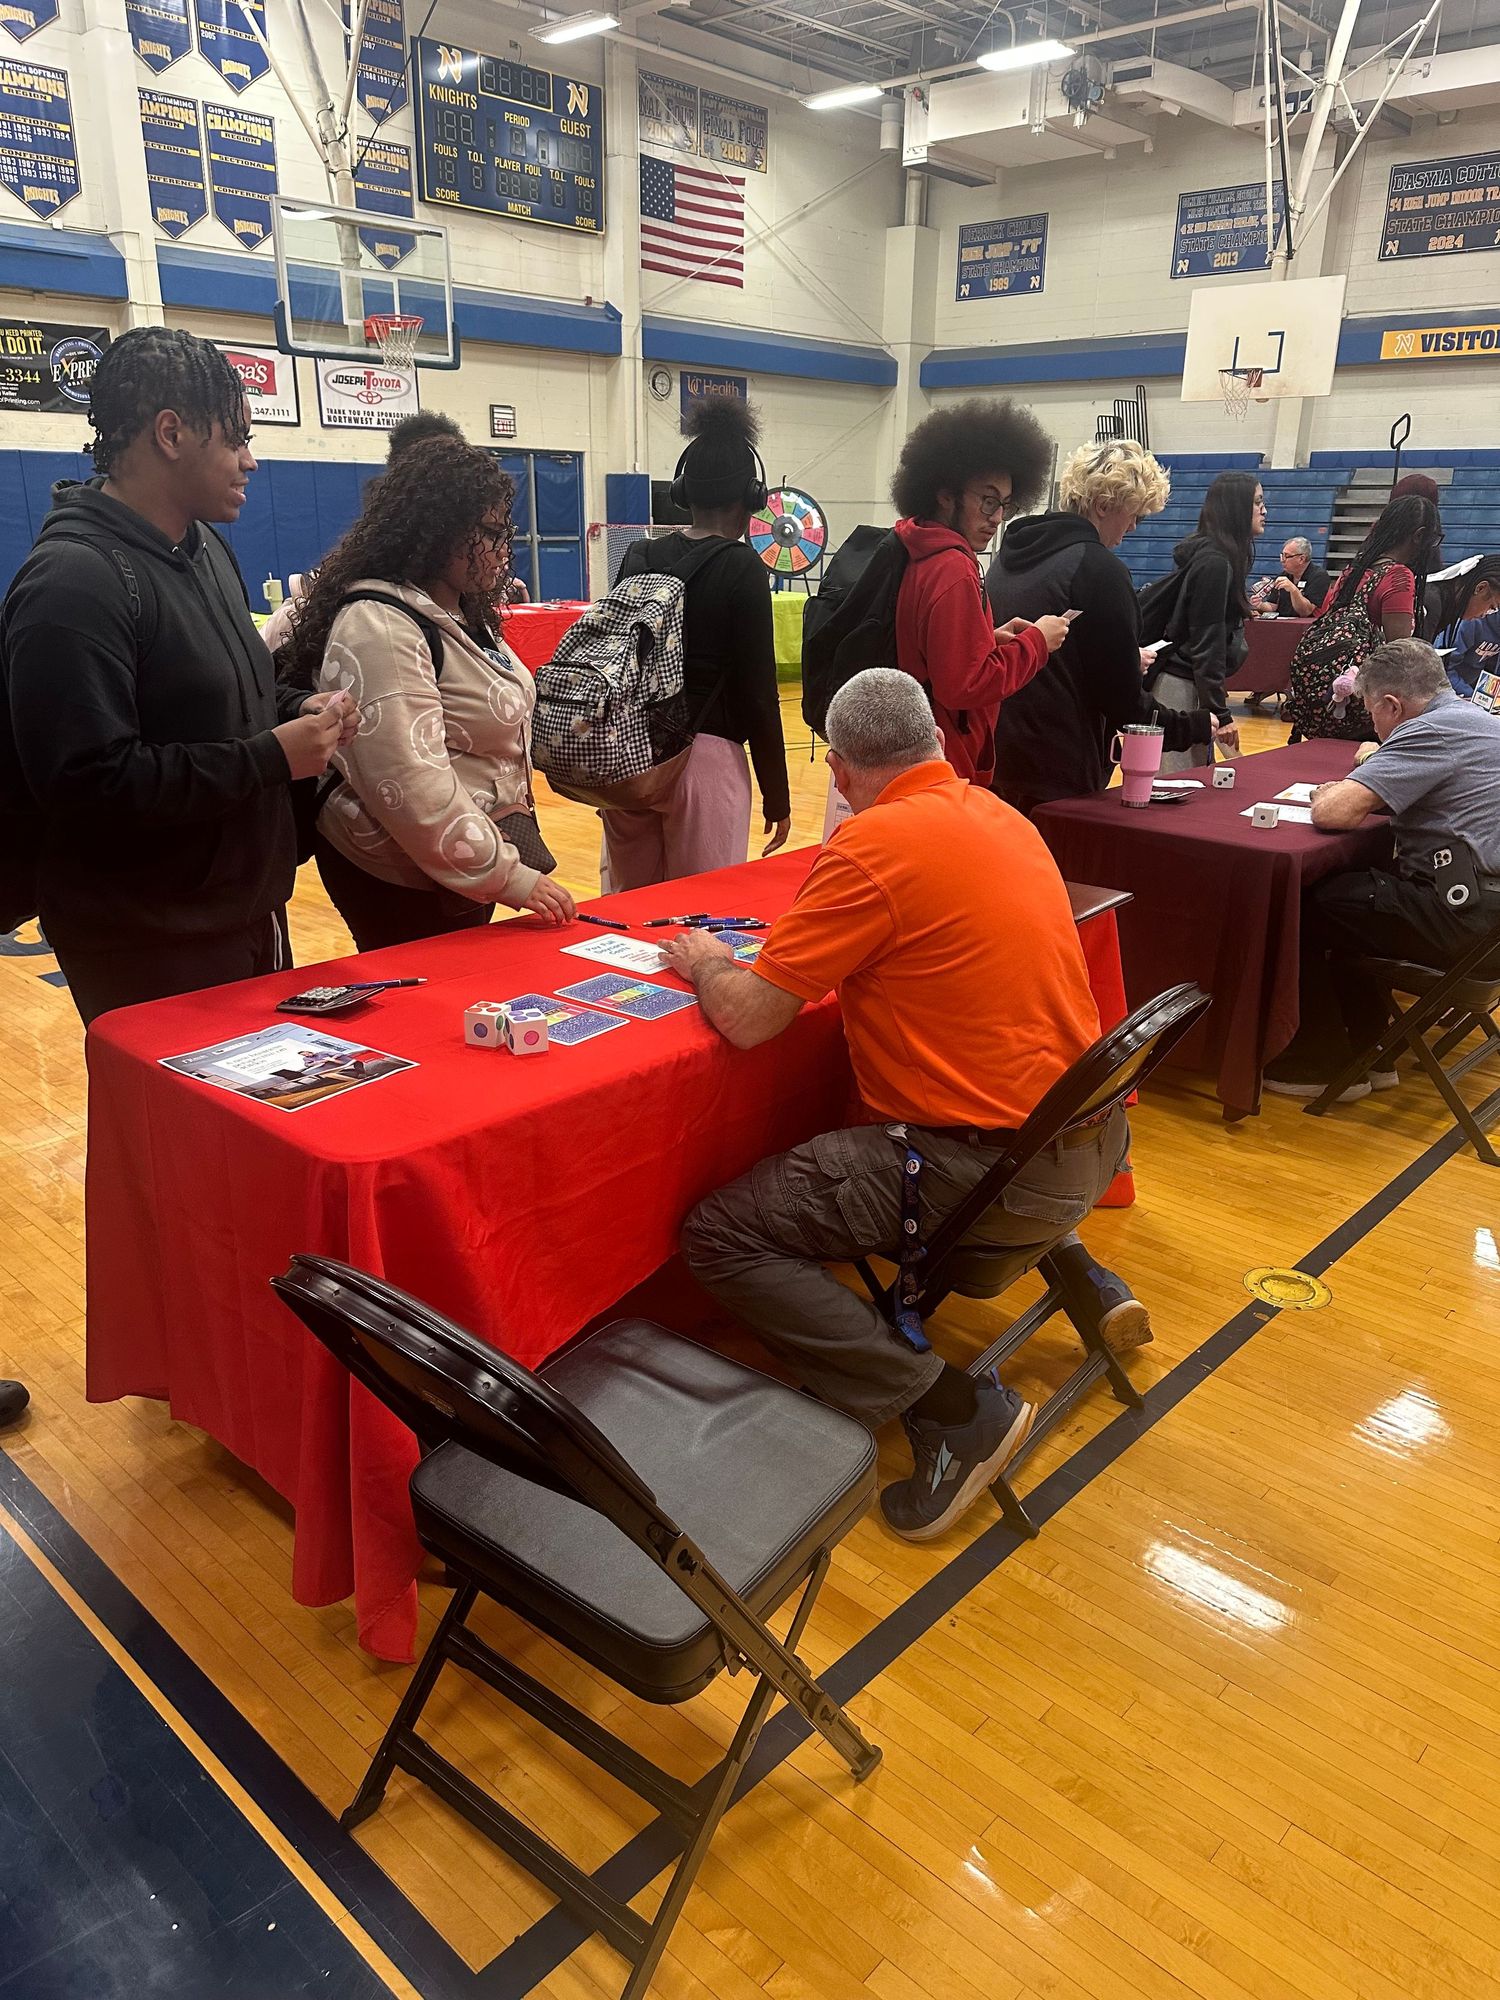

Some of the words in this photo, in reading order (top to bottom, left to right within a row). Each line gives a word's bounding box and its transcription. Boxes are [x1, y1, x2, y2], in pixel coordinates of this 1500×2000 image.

[200, 29, 217, 41] 2005
[5, 61, 27, 72] PITCH
[28, 66, 65, 81] SOFTBALL
[7, 87, 48, 101] REGION
[151, 94, 194, 109] SWIMMING
[428, 83, 478, 111] KNIGHTS
[0, 112, 61, 130] SECTIONAL
[140, 100, 197, 127] AMPIONS
[207, 105, 236, 118] GIRLS
[237, 111, 271, 126] TENNIS
[504, 111, 530, 129] PERIOD
[145, 116, 181, 129] REGION
[206, 113, 273, 143] CHAMPIONS
[559, 118, 592, 140] GUEST
[703, 108, 735, 142] FINAL
[736, 119, 766, 150] FOUR
[13, 122, 32, 134] 1992
[33, 126, 51, 137] 1993
[53, 130, 71, 141] 1994
[14, 131, 32, 143] 1996
[224, 132, 258, 145] REGION
[144, 141, 191, 155] ECTIONAL
[357, 139, 406, 155] WRESTLING
[433, 142, 458, 158] FOULS
[1, 148, 70, 166] CONFERENCE
[18, 158, 35, 169] 1987
[218, 154, 268, 170] SECTIONAL
[467, 150, 487, 165] T.O.L.
[367, 162, 396, 173] REGION
[494, 156, 521, 173] PLAYER
[524, 163, 542, 177] FOUL
[39, 170, 57, 180] 1994
[59, 173, 76, 184] 1995
[549, 169, 567, 183] T.O.L.
[574, 175, 596, 189] FOULS
[362, 183, 404, 196] SECTIONAL
[435, 187, 461, 202] SCORE
[1425, 191, 1451, 209] JUMP
[507, 201, 532, 216] MATCH
[575, 215, 597, 229] SCORE
[1387, 215, 1433, 235] STATE
[963, 223, 1004, 244] DERRICK
[1007, 217, 1044, 237] CHILDS
[1180, 235, 1216, 254] STATE
[1427, 233, 1464, 251] 2024
[1213, 250, 1239, 268] 2013
[961, 262, 991, 279] STATE
[992, 256, 1040, 276] CHAMPION
[5, 329, 20, 337] NEED
[7, 336, 27, 355] DO
[29, 337, 47, 355] IT.
[332, 374, 366, 386] JOSEPH
[703, 379, 739, 397] Health
[250, 407, 290, 417] .347.1111
[326, 407, 346, 416] THANK
[348, 409, 361, 417] YOU
[326, 415, 373, 426] NORTHWEST
